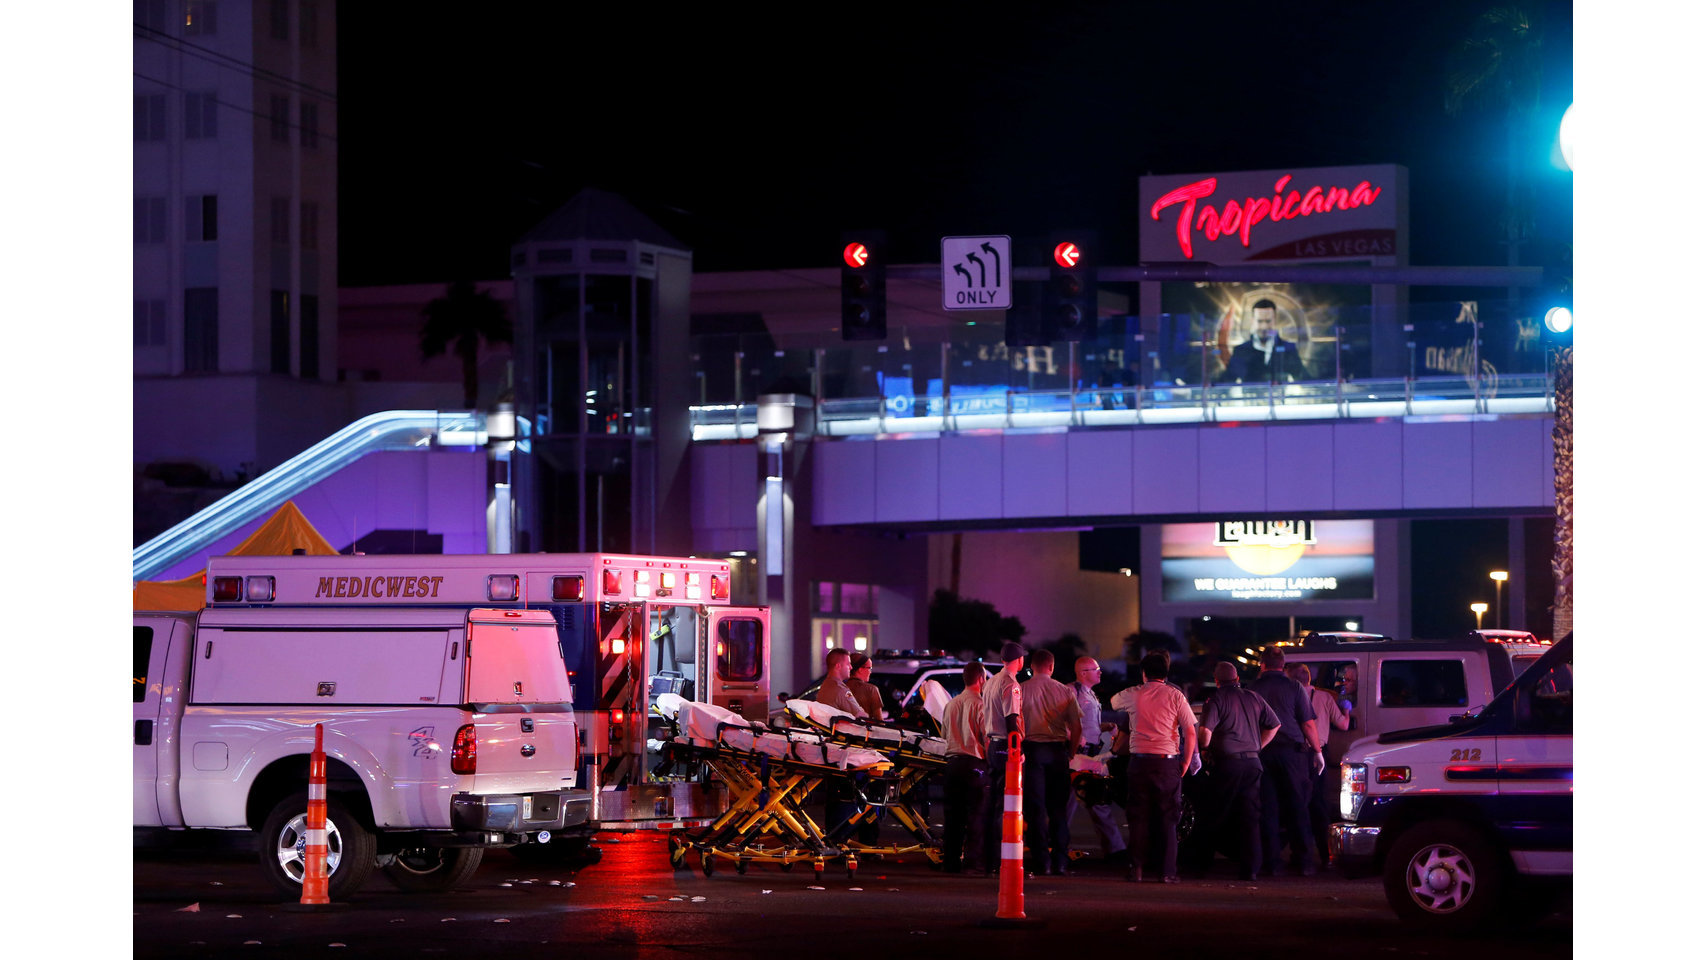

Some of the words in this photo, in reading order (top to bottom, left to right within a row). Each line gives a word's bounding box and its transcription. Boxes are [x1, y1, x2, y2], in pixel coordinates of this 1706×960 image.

[1150, 174, 1382, 259] Tropicana
[1295, 240, 1328, 257] LAS
[1331, 238, 1392, 255] VEGAS
[956, 289, 997, 304] ONLY
[315, 576, 444, 598] MEDICWEST
[1194, 578, 1215, 590] WE
[1215, 577, 1287, 590] GUARANTEE
[1287, 576, 1337, 588] LAUGHS
[1450, 748, 1481, 761] 212
